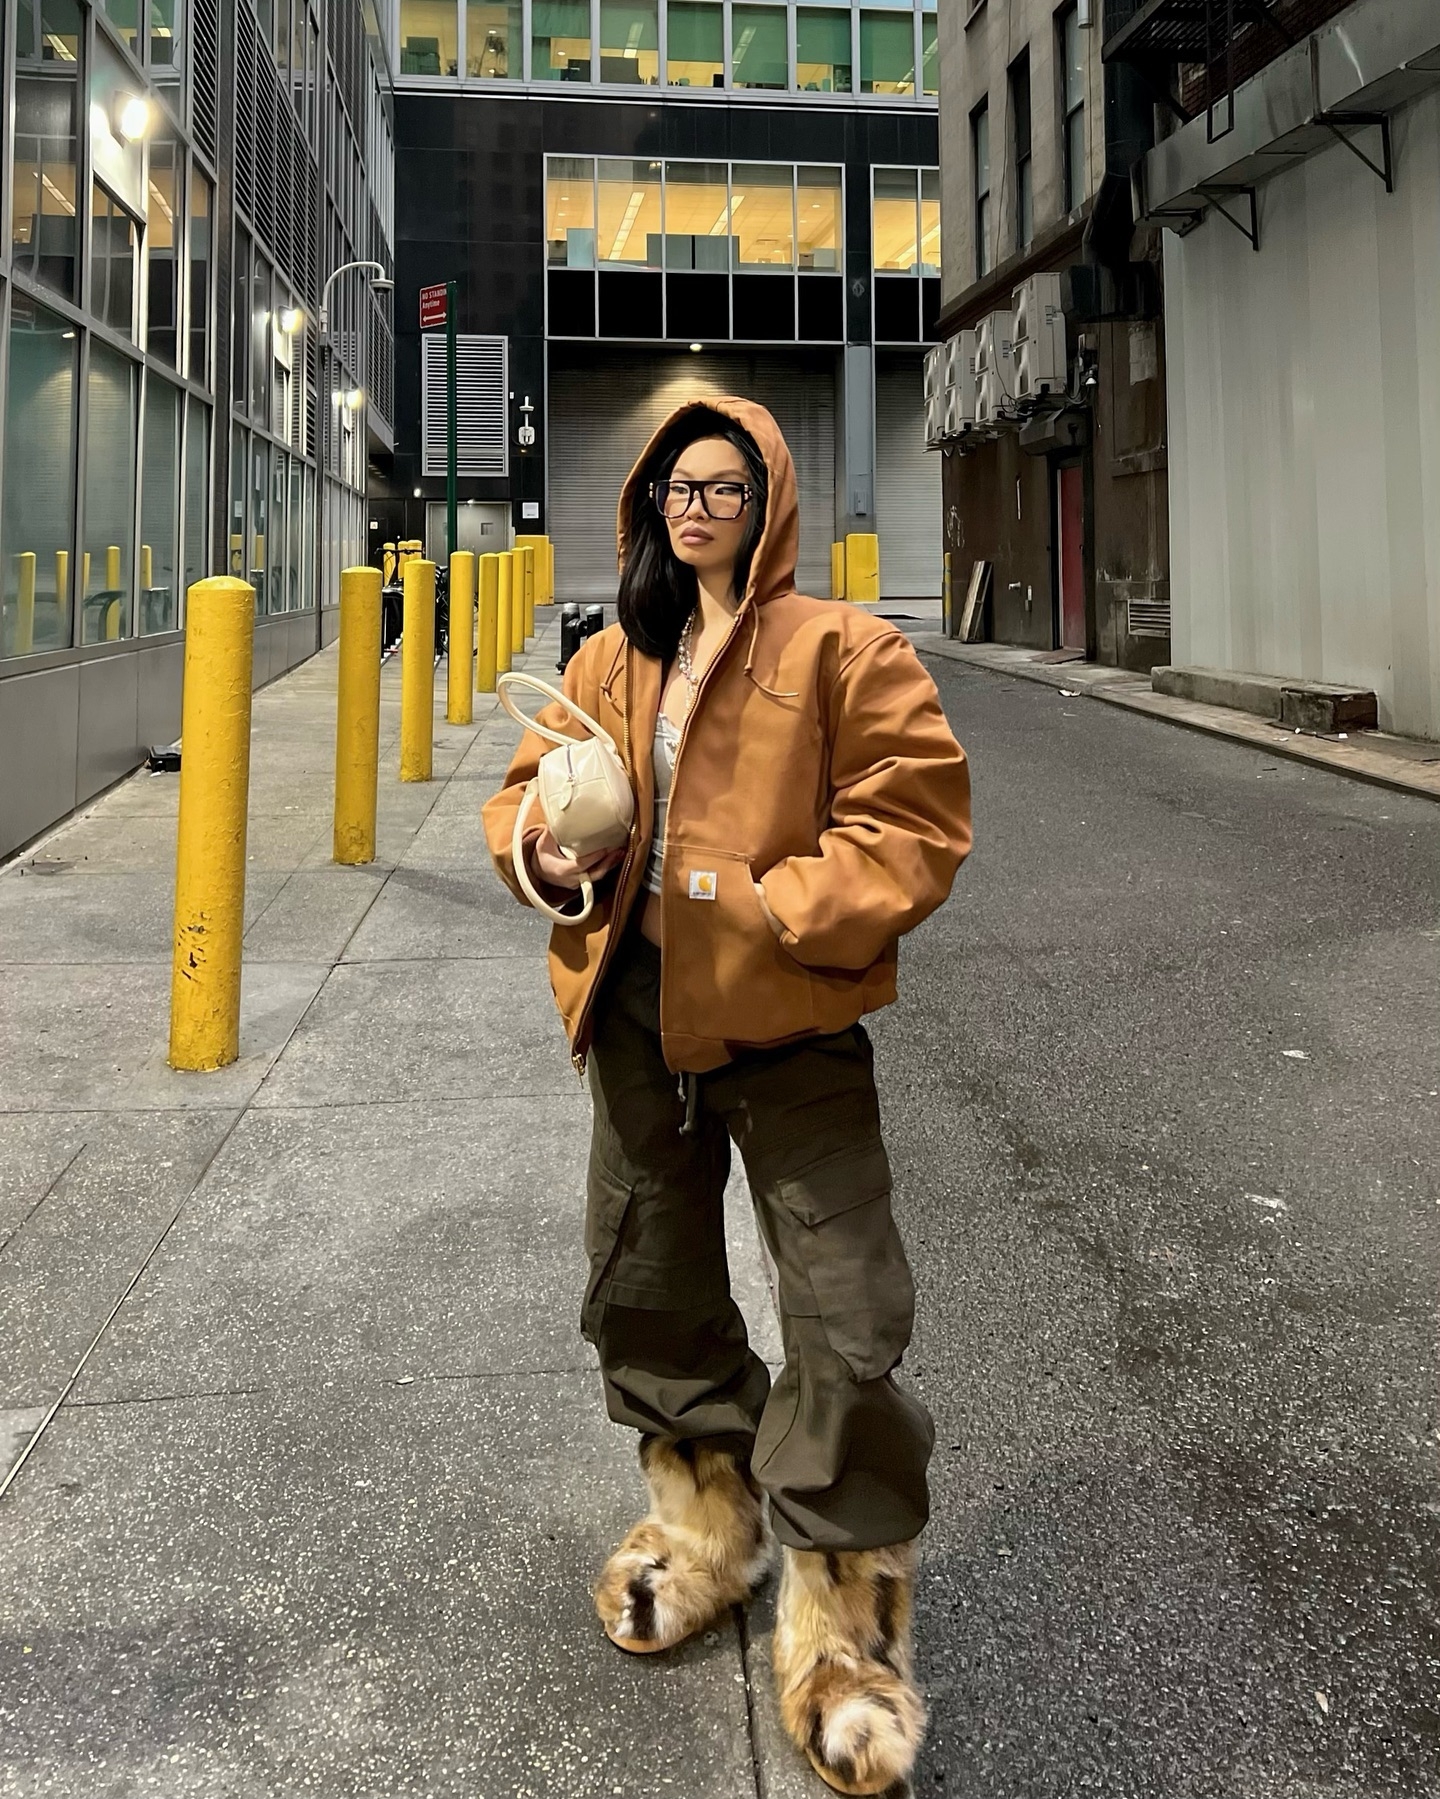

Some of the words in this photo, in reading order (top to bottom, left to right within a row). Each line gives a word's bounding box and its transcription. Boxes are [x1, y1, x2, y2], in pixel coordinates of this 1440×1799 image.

[422, 292, 428, 300] NO
[429, 288, 447, 299] STANDIN
[422, 300, 440, 310] Anytime
